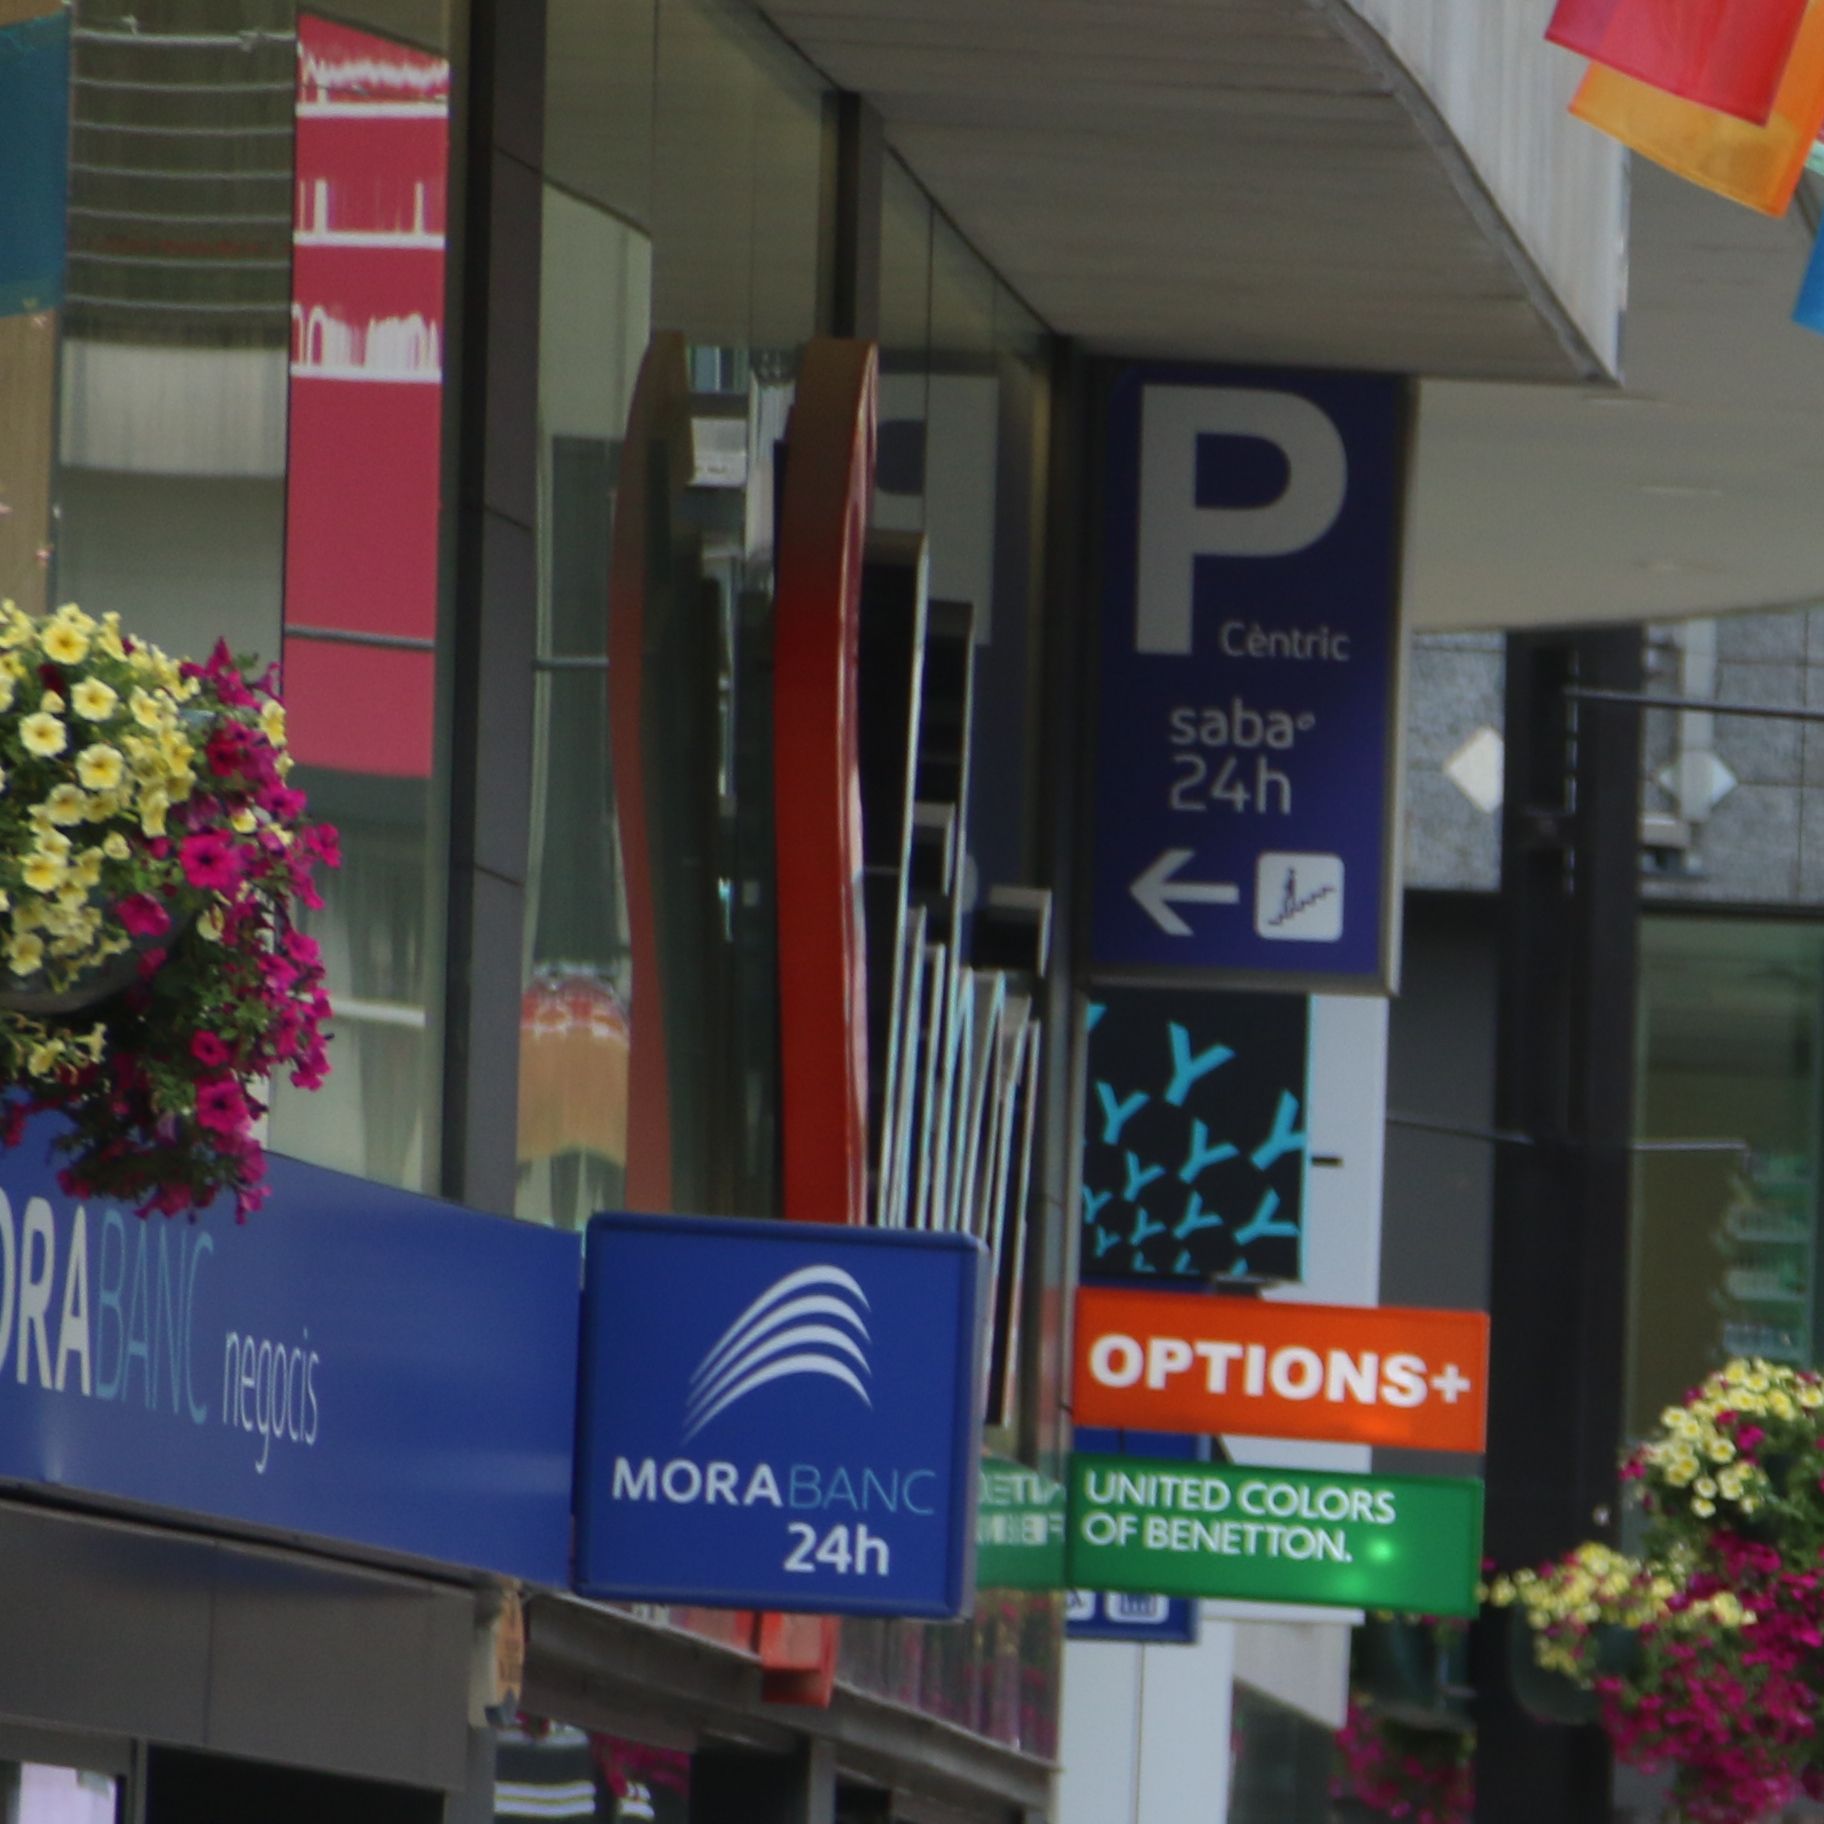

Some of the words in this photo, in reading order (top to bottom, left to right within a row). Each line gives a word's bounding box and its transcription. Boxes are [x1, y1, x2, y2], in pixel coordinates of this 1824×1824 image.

[1136, 384, 1348, 655] P
[1169, 754, 1293, 815] 24h
[222, 1325, 320, 1475] negocis
[1089, 1333, 1471, 1408] OPTIONS+
[611, 1456, 937, 1517] MORABANC
[1085, 1470, 1232, 1513] UNITED
[1237, 1481, 1397, 1525] COLORS
[783, 1521, 890, 1577] 24h
[1082, 1513, 1138, 1547] OF
